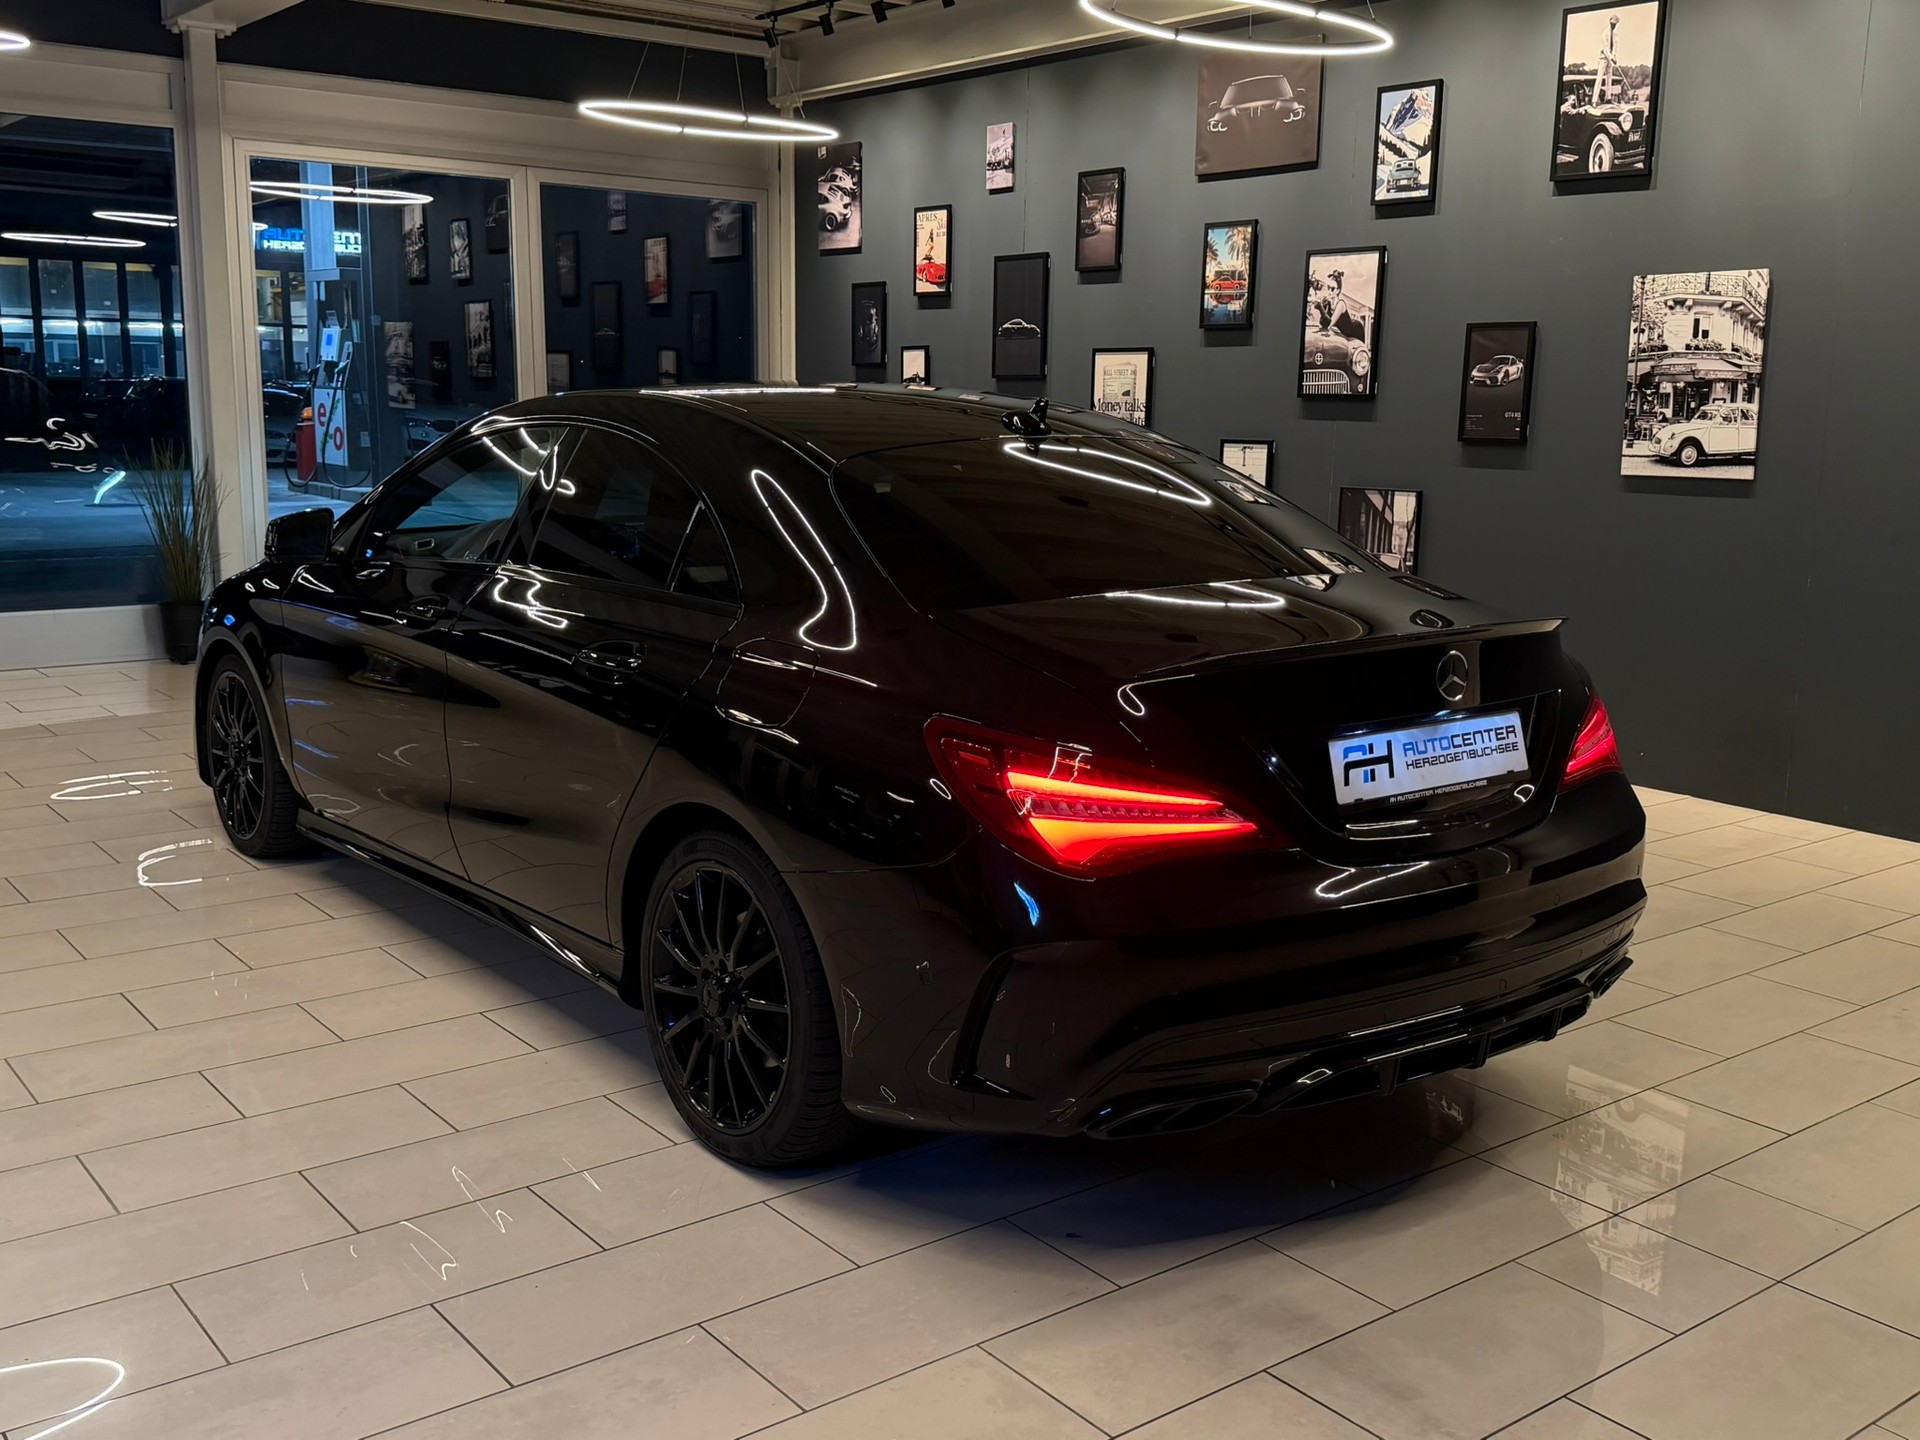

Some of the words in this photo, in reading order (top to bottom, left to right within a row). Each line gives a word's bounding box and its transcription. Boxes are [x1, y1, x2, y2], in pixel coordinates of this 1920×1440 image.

[1124, 398, 1146, 412] talks
[1402, 724, 1517, 757] AUTOCENTER
[1405, 741, 1520, 771] HERZOGENBUCHSEE
